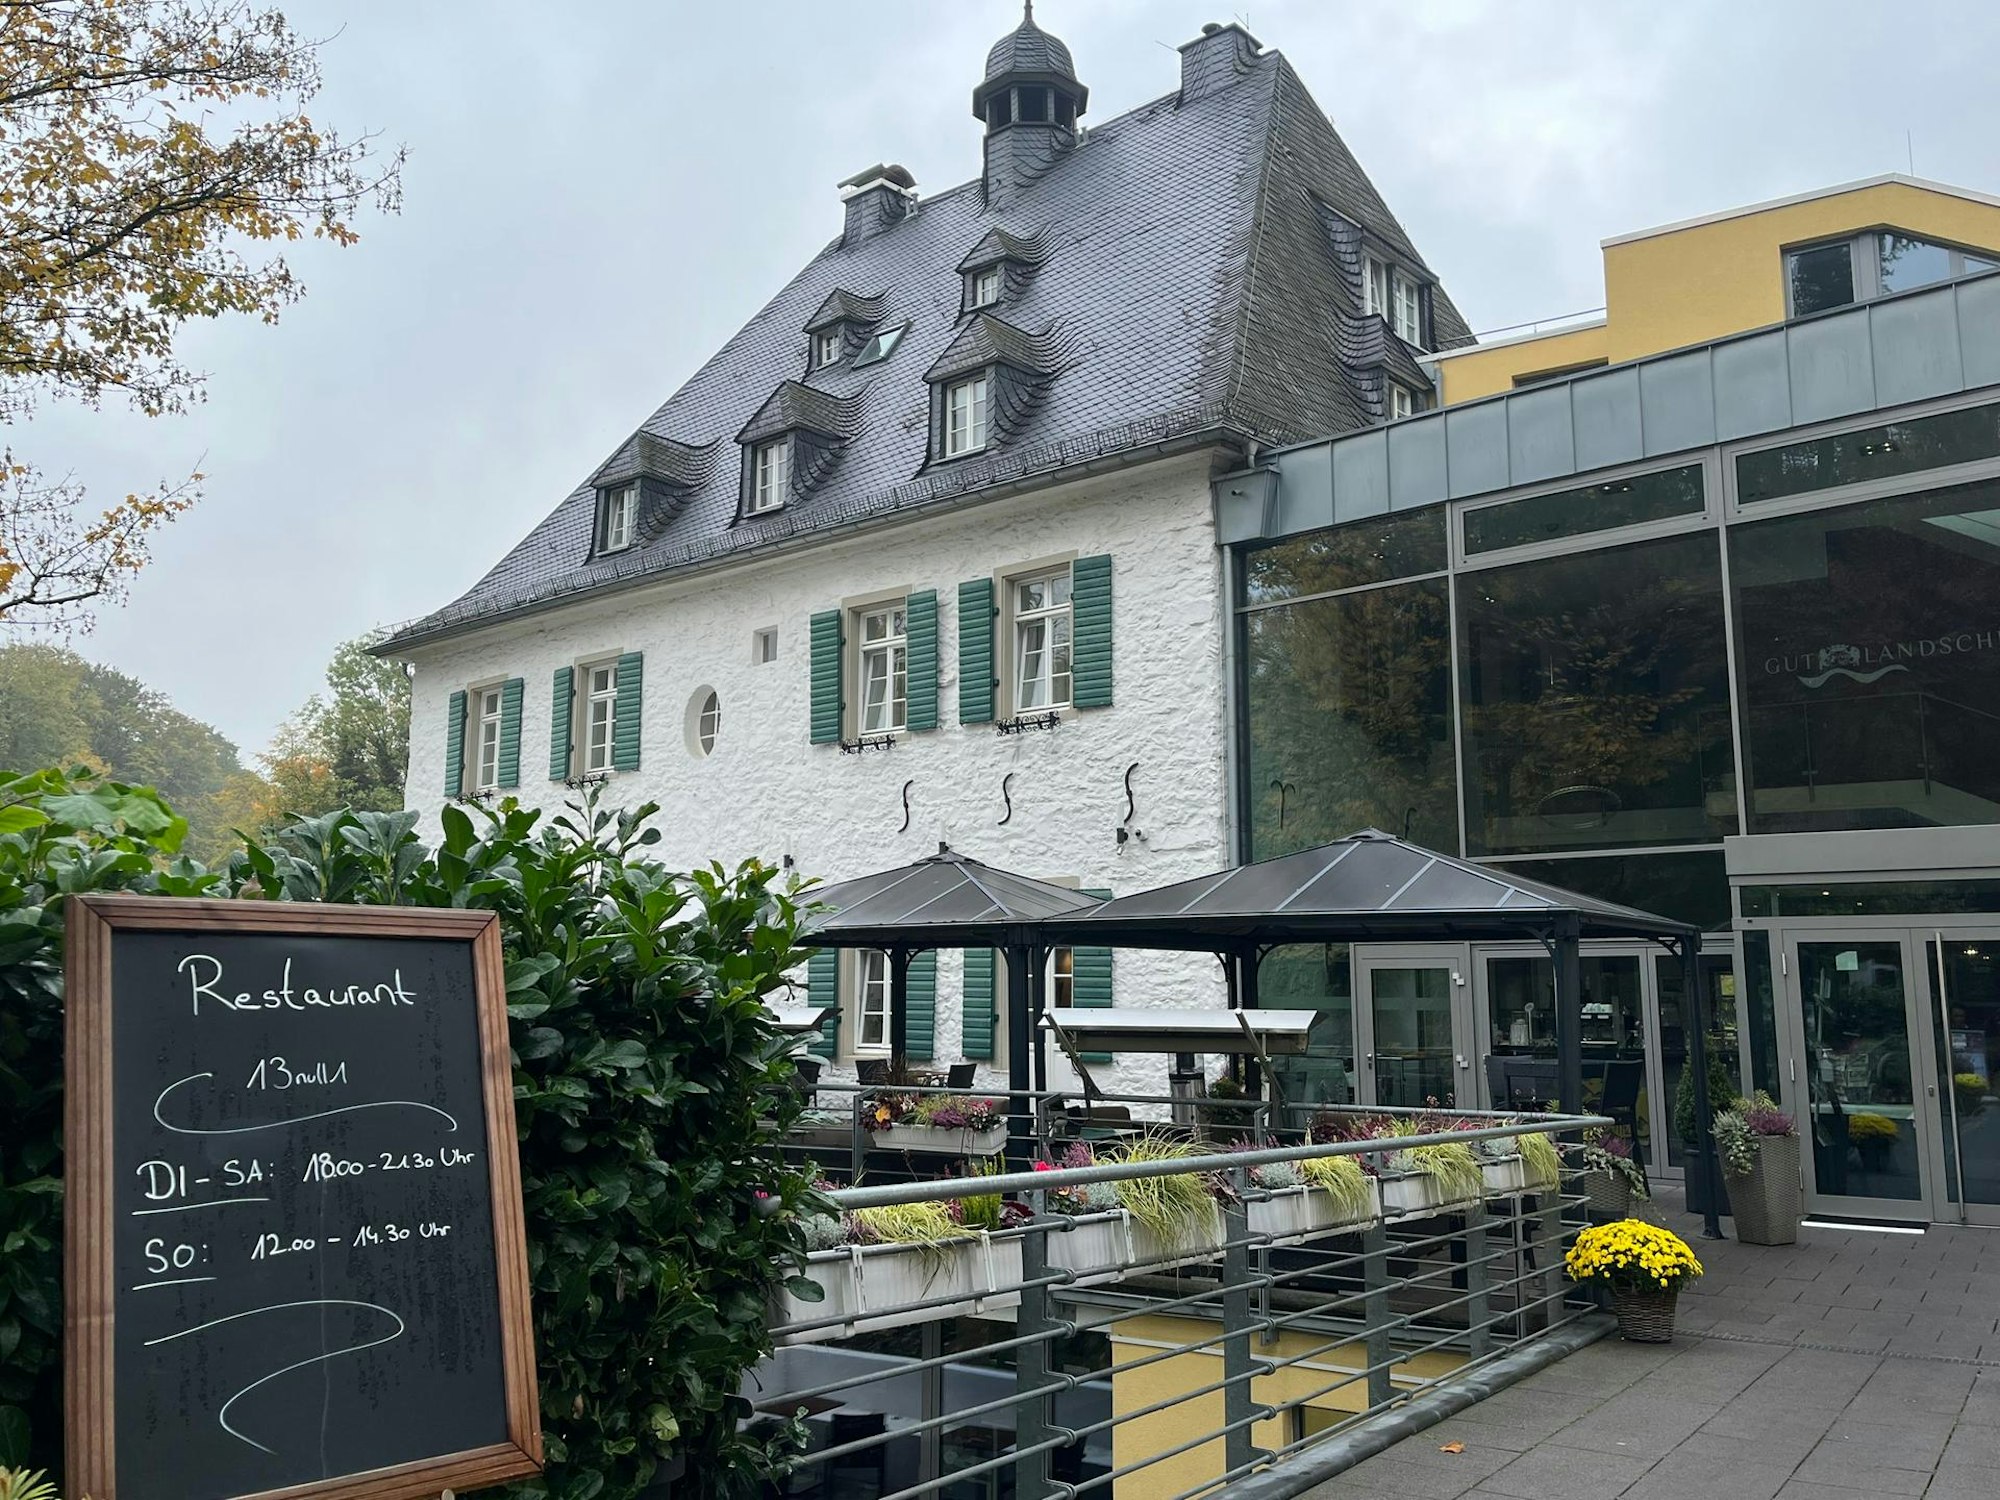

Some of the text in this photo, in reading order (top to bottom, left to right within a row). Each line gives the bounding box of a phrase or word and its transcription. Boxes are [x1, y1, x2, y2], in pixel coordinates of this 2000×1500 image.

[1764, 630, 2000, 675] GUT LANDSCH
[177, 954, 417, 1016] Restaurant
[136, 1160, 186, 1200] DI
[223, 1159, 274, 1187] SA:
[440, 1147, 476, 1167] Uhr
[144, 1238, 209, 1273] SO:
[250, 1233, 316, 1260] 12.00
[352, 1223, 411, 1247] 14.30
[418, 1222, 451, 1238] Uhr
